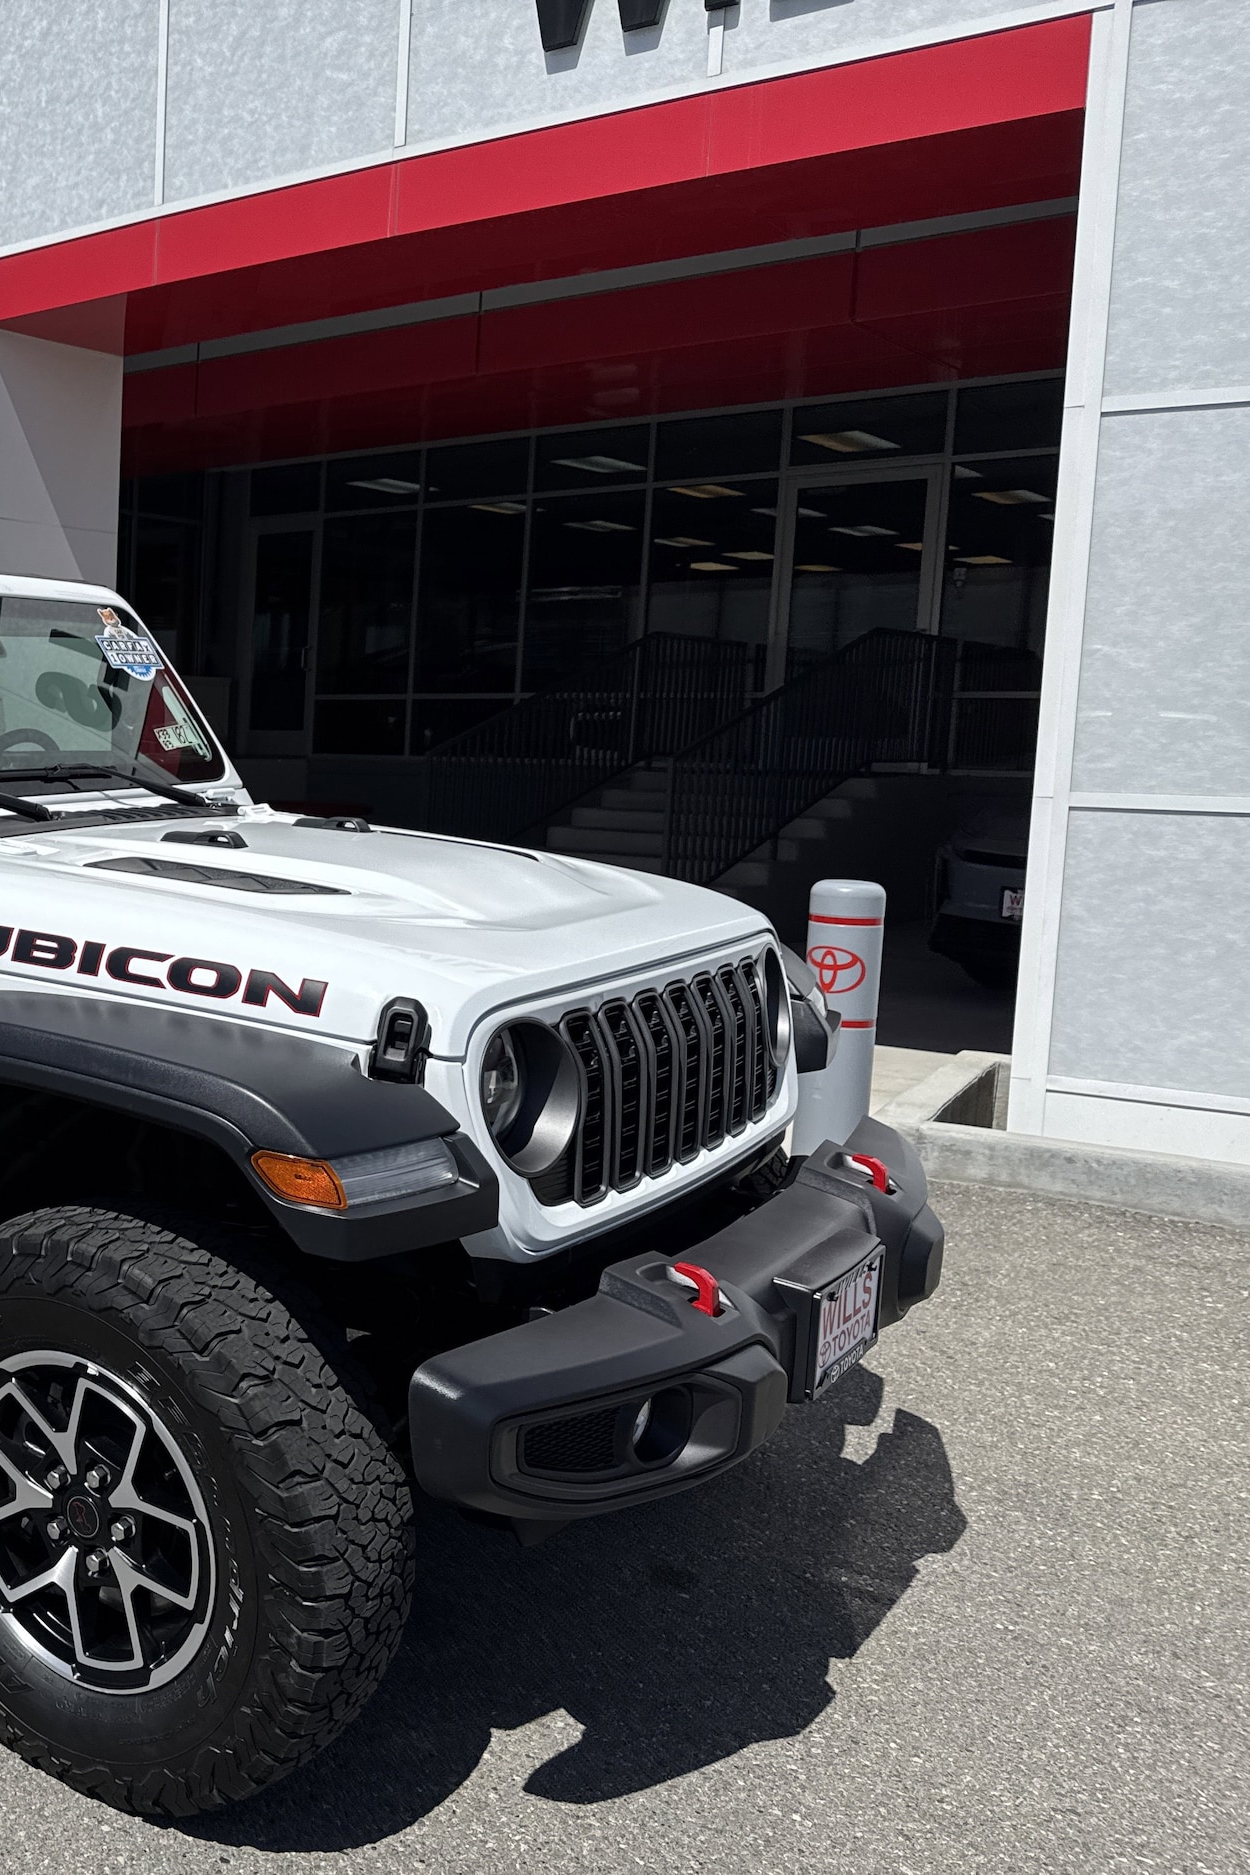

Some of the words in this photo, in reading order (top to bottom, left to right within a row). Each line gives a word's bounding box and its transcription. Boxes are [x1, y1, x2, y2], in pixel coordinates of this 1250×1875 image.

[103, 640, 153, 653] CARFAX
[822, 1271, 873, 1341] WILLS
[832, 1310, 871, 1357] TOYOTA
[840, 1344, 864, 1375] TOYOTA
